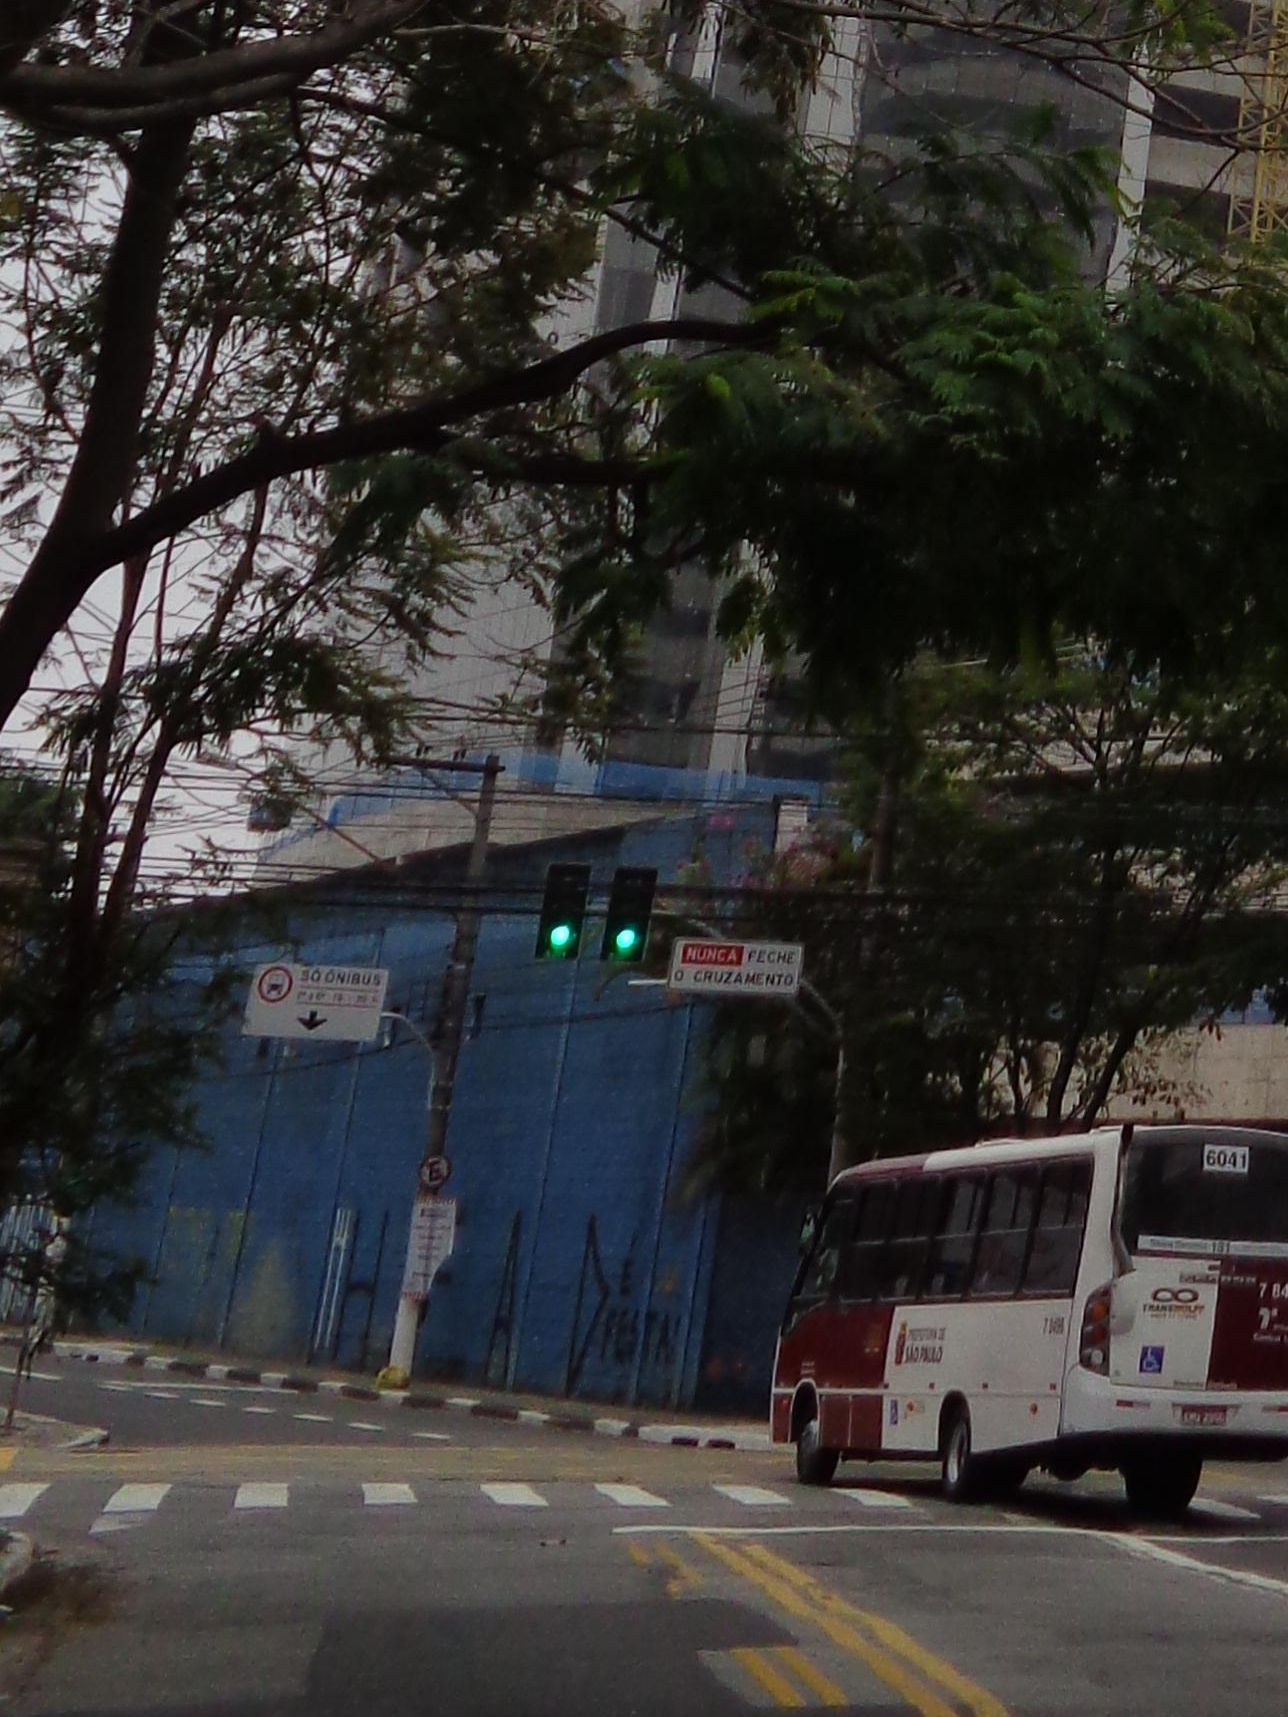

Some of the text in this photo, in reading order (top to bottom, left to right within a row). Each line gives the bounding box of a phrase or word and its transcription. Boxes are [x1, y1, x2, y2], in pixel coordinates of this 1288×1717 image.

[686, 946, 795, 964] NUNCA FECHE
[674, 970, 793, 986] O CRUZAMENTO
[1206, 1149, 1247, 1169] 6041
